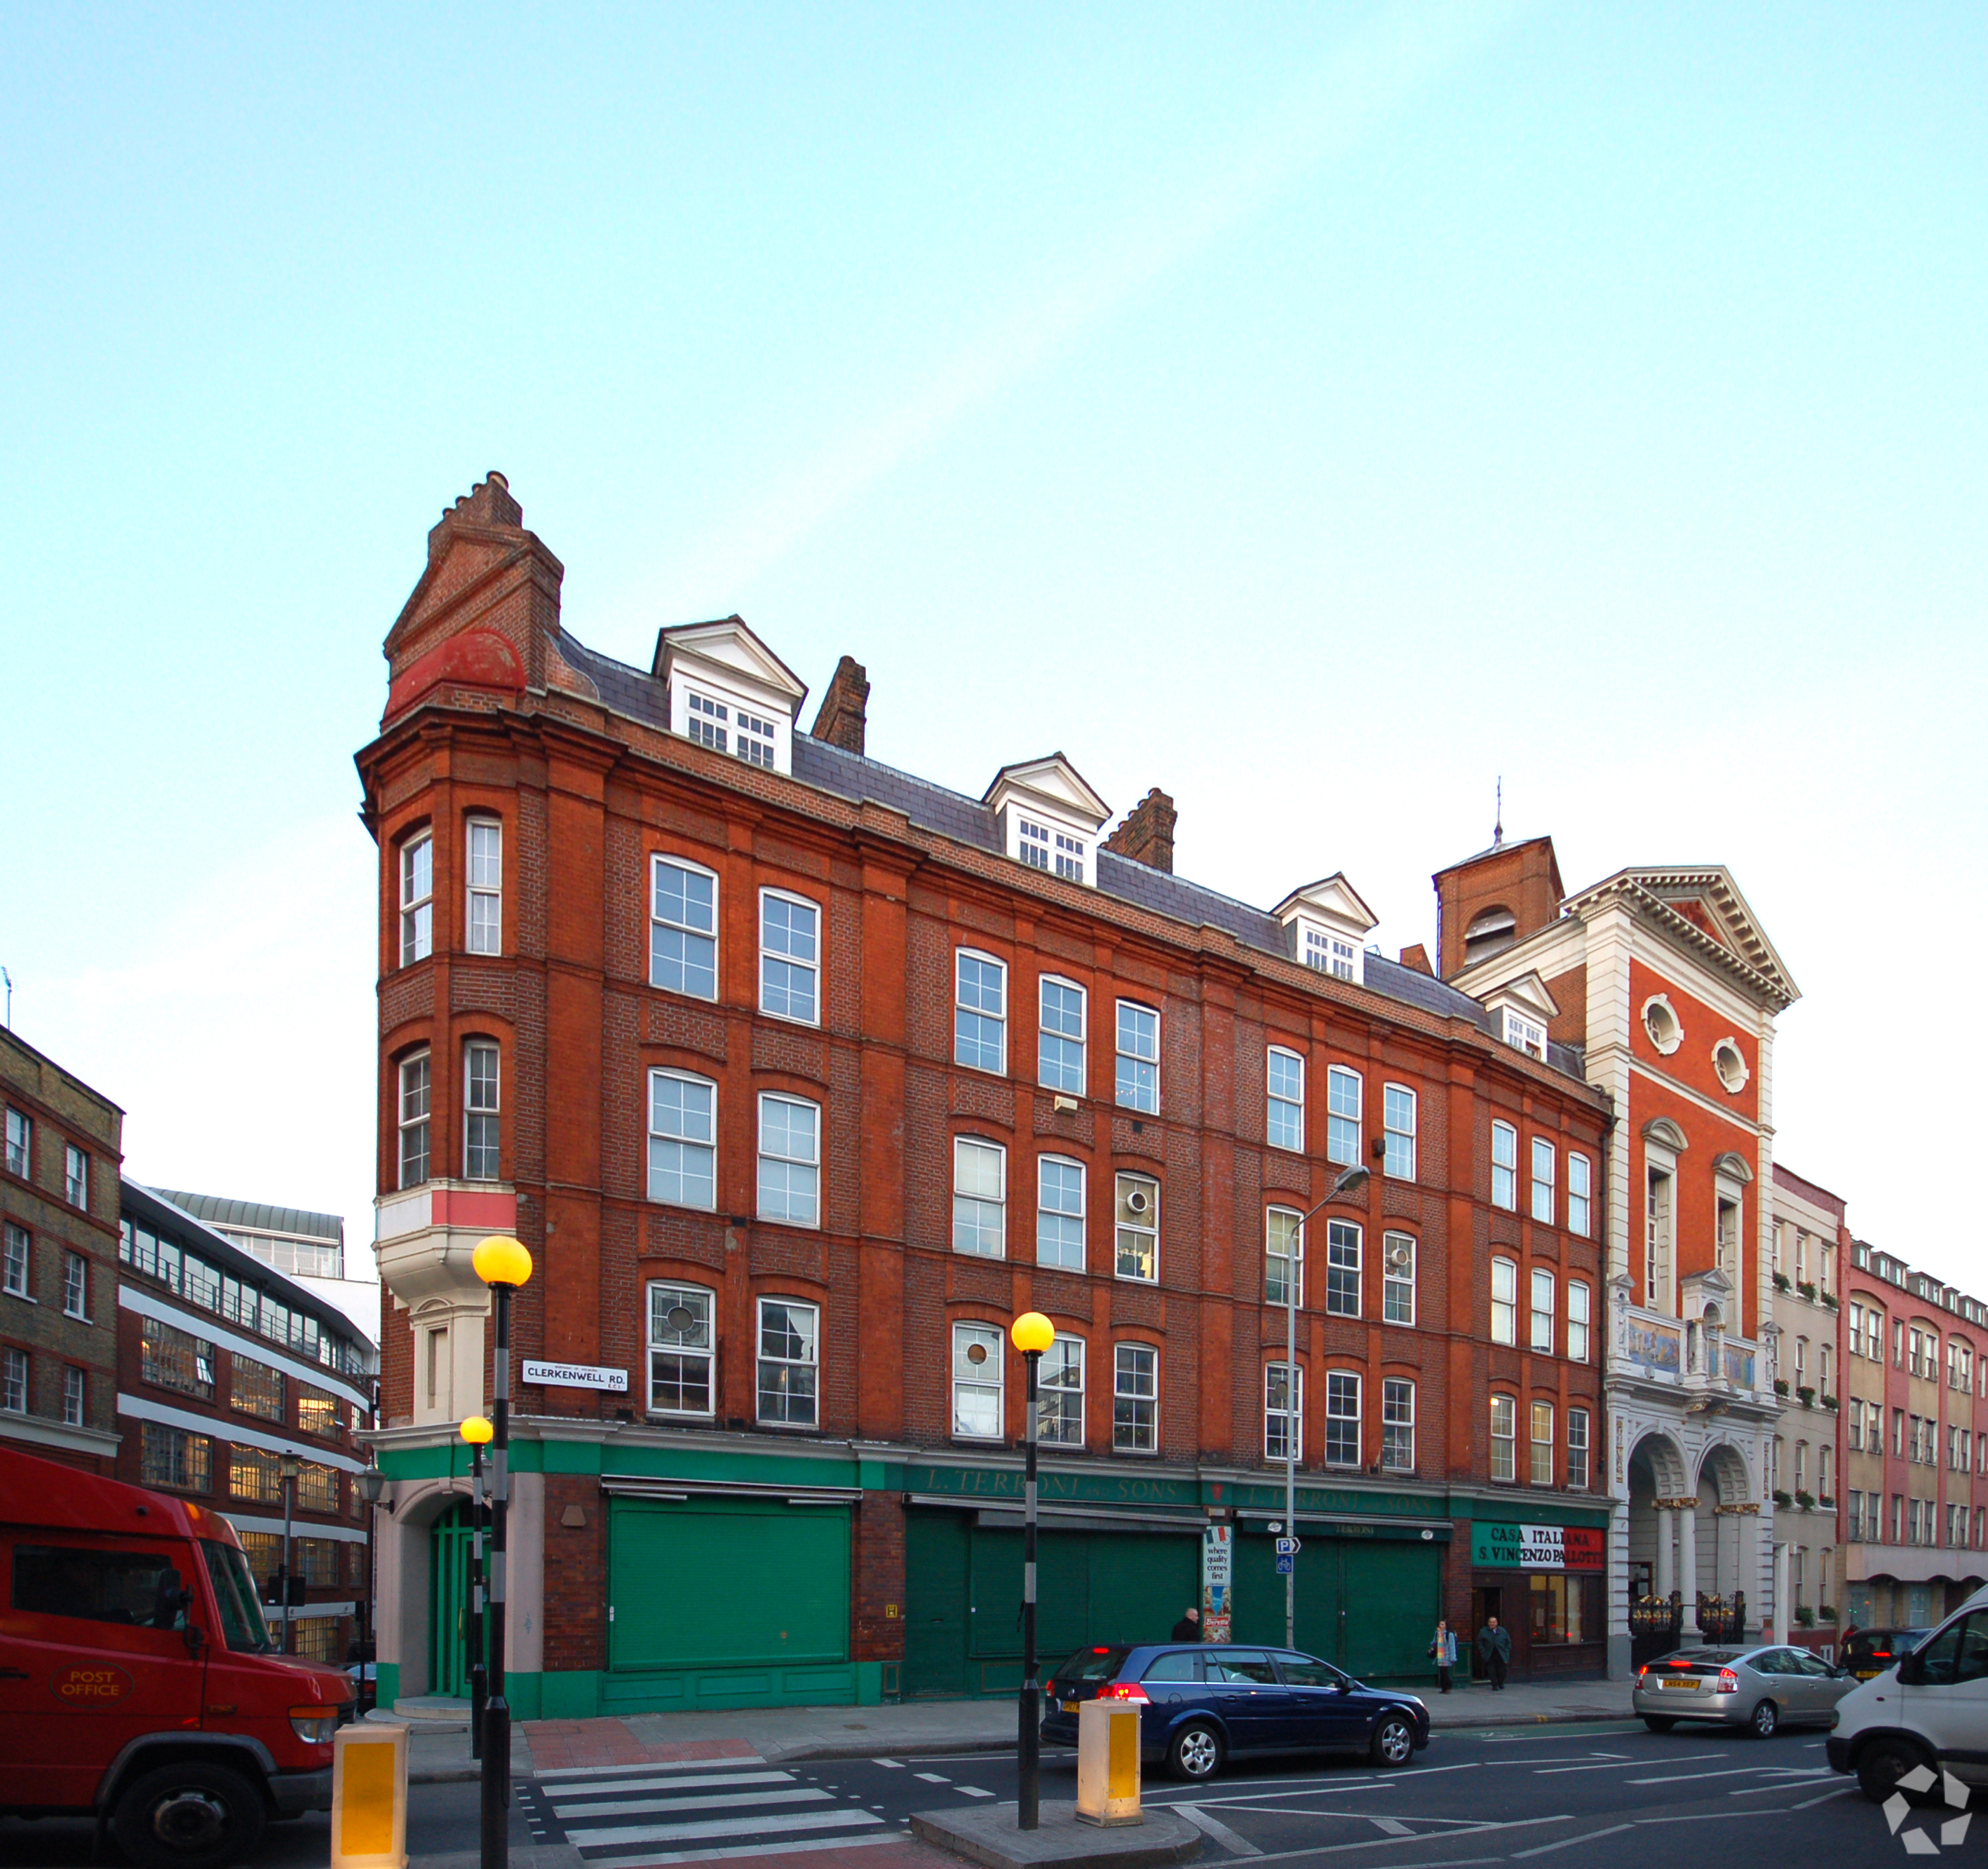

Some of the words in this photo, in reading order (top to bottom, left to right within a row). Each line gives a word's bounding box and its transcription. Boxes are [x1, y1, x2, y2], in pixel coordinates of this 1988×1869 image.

[527, 1367, 604, 1382] CLERKENWELL
[609, 1375, 625, 1385] RD.
[926, 1469, 948, 1490] L.
[955, 1469, 1078, 1496] TERRONI
[1118, 1479, 1177, 1500] SONS
[1491, 1528, 1525, 1543] CASA
[1532, 1530, 1590, 1547] ITALIANA
[1280, 1541, 1289, 1551] P
[1207, 1555, 1227, 1564] quality
[1492, 1547, 1552, 1562] VINCENZO
[71, 1671, 115, 1683] POST
[62, 1684, 120, 1696] OFFICE
